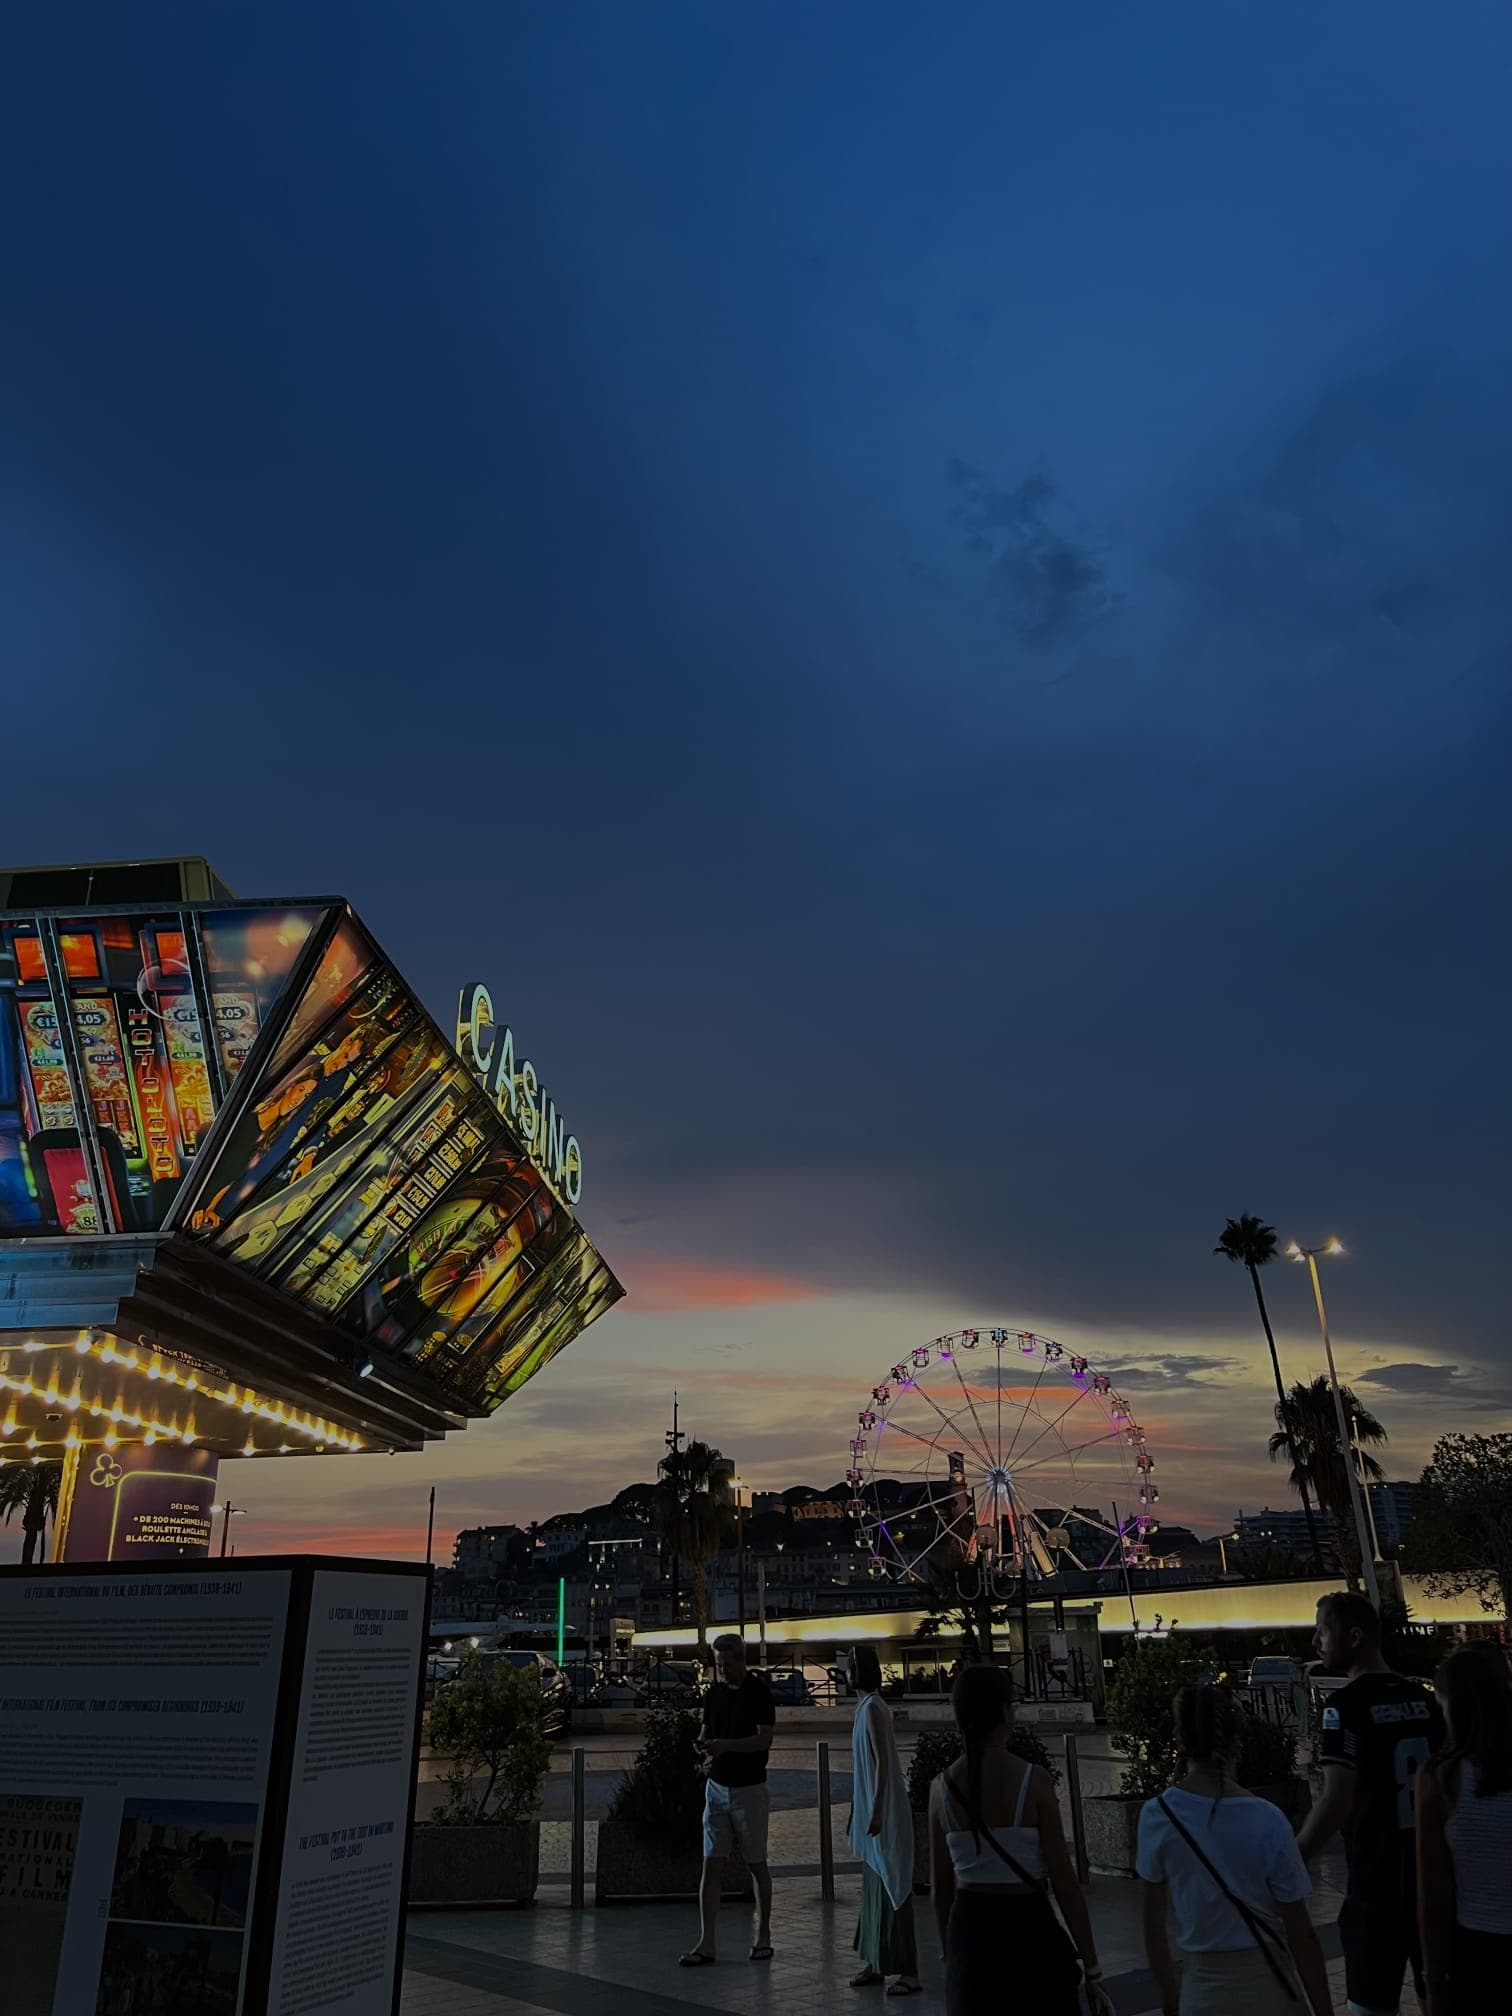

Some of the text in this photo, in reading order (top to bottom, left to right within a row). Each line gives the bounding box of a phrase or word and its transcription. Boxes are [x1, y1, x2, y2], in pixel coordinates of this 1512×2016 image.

[462, 983, 582, 1205] CASINO
[139, 1515, 152, 1523] DE
[152, 1516, 169, 1524] 200
[141, 1525, 182, 1534] ROULETTE
[125, 1534, 155, 1543] BLACK
[155, 1535, 176, 1544] JACK
